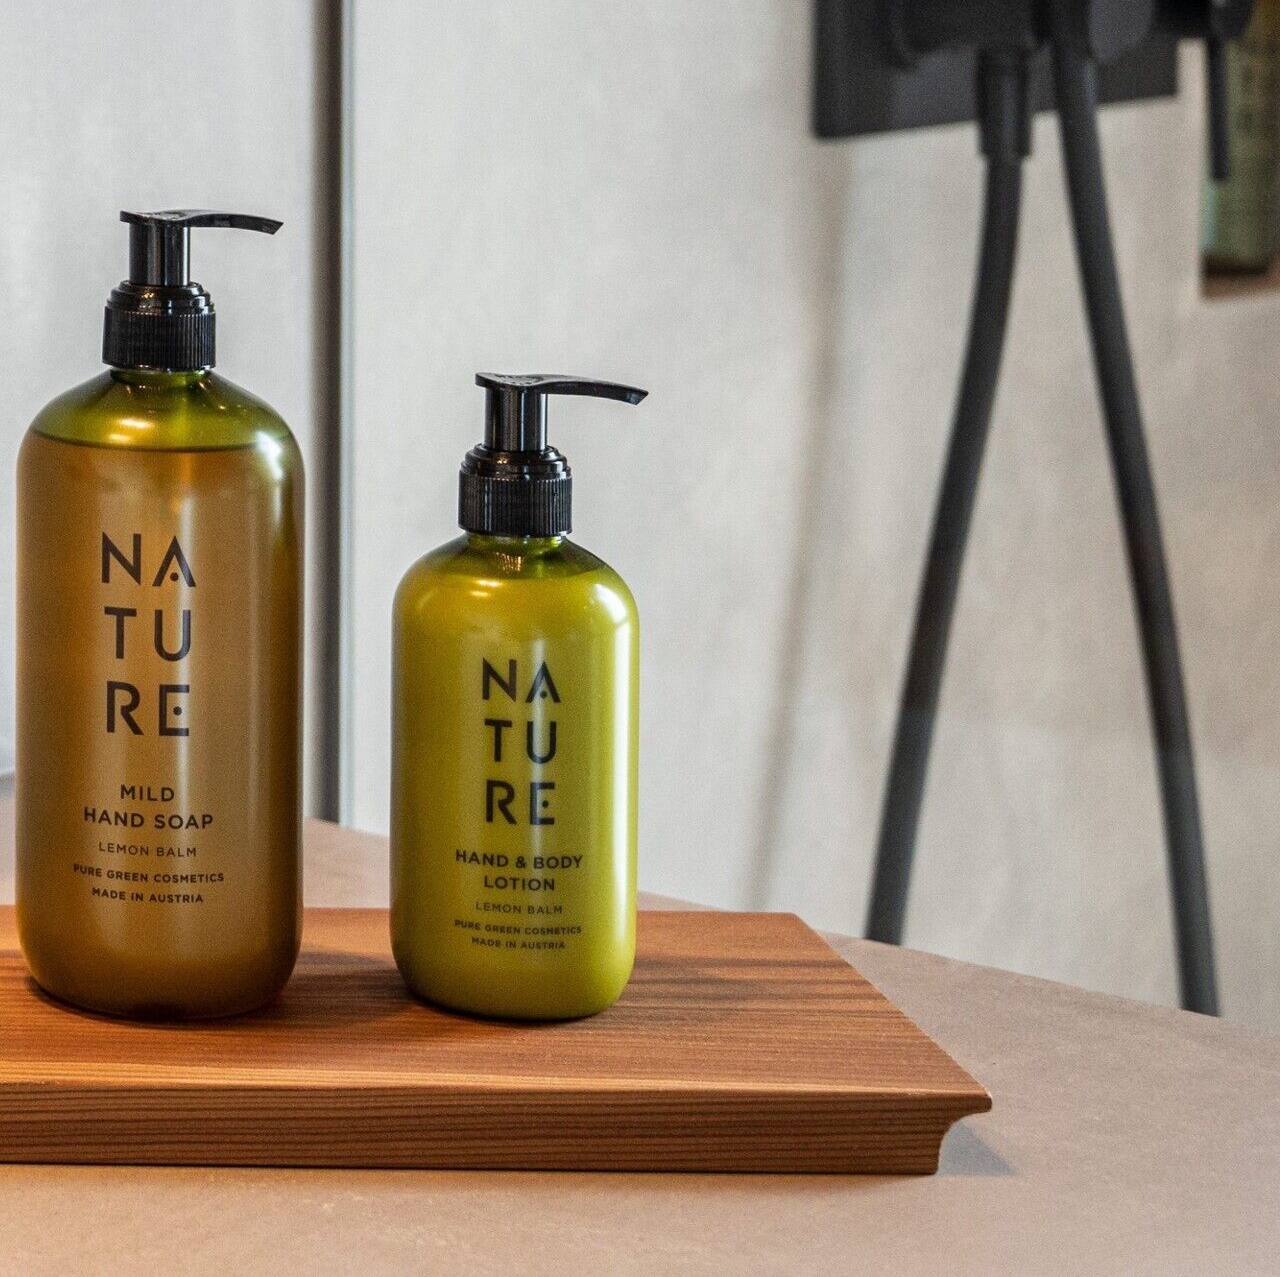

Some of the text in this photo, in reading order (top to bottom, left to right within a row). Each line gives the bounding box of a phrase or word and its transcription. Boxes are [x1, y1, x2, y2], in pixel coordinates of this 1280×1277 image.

[101, 531, 197, 588] NA
[103, 606, 192, 662] TU
[481, 657, 562, 704] NA
[106, 680, 191, 737] RE
[484, 718, 557, 765] TU
[120, 784, 175, 802] MILD
[485, 779, 556, 826] RE
[83, 806, 214, 830] HAND SOAP
[98, 841, 197, 858] LEMON BALM
[455, 848, 583, 869] HAND & BODY
[73, 863, 225, 884] PURE GREEN COSMETICS
[483, 875, 555, 891] LOTION
[91, 887, 204, 904] MADE IN AUSTRIA
[475, 901, 563, 915] LEMON BALM
[454, 919, 582, 936] PURE GREEN COSMETICS
[471, 936, 566, 950] MADE IN AUSTRIA
